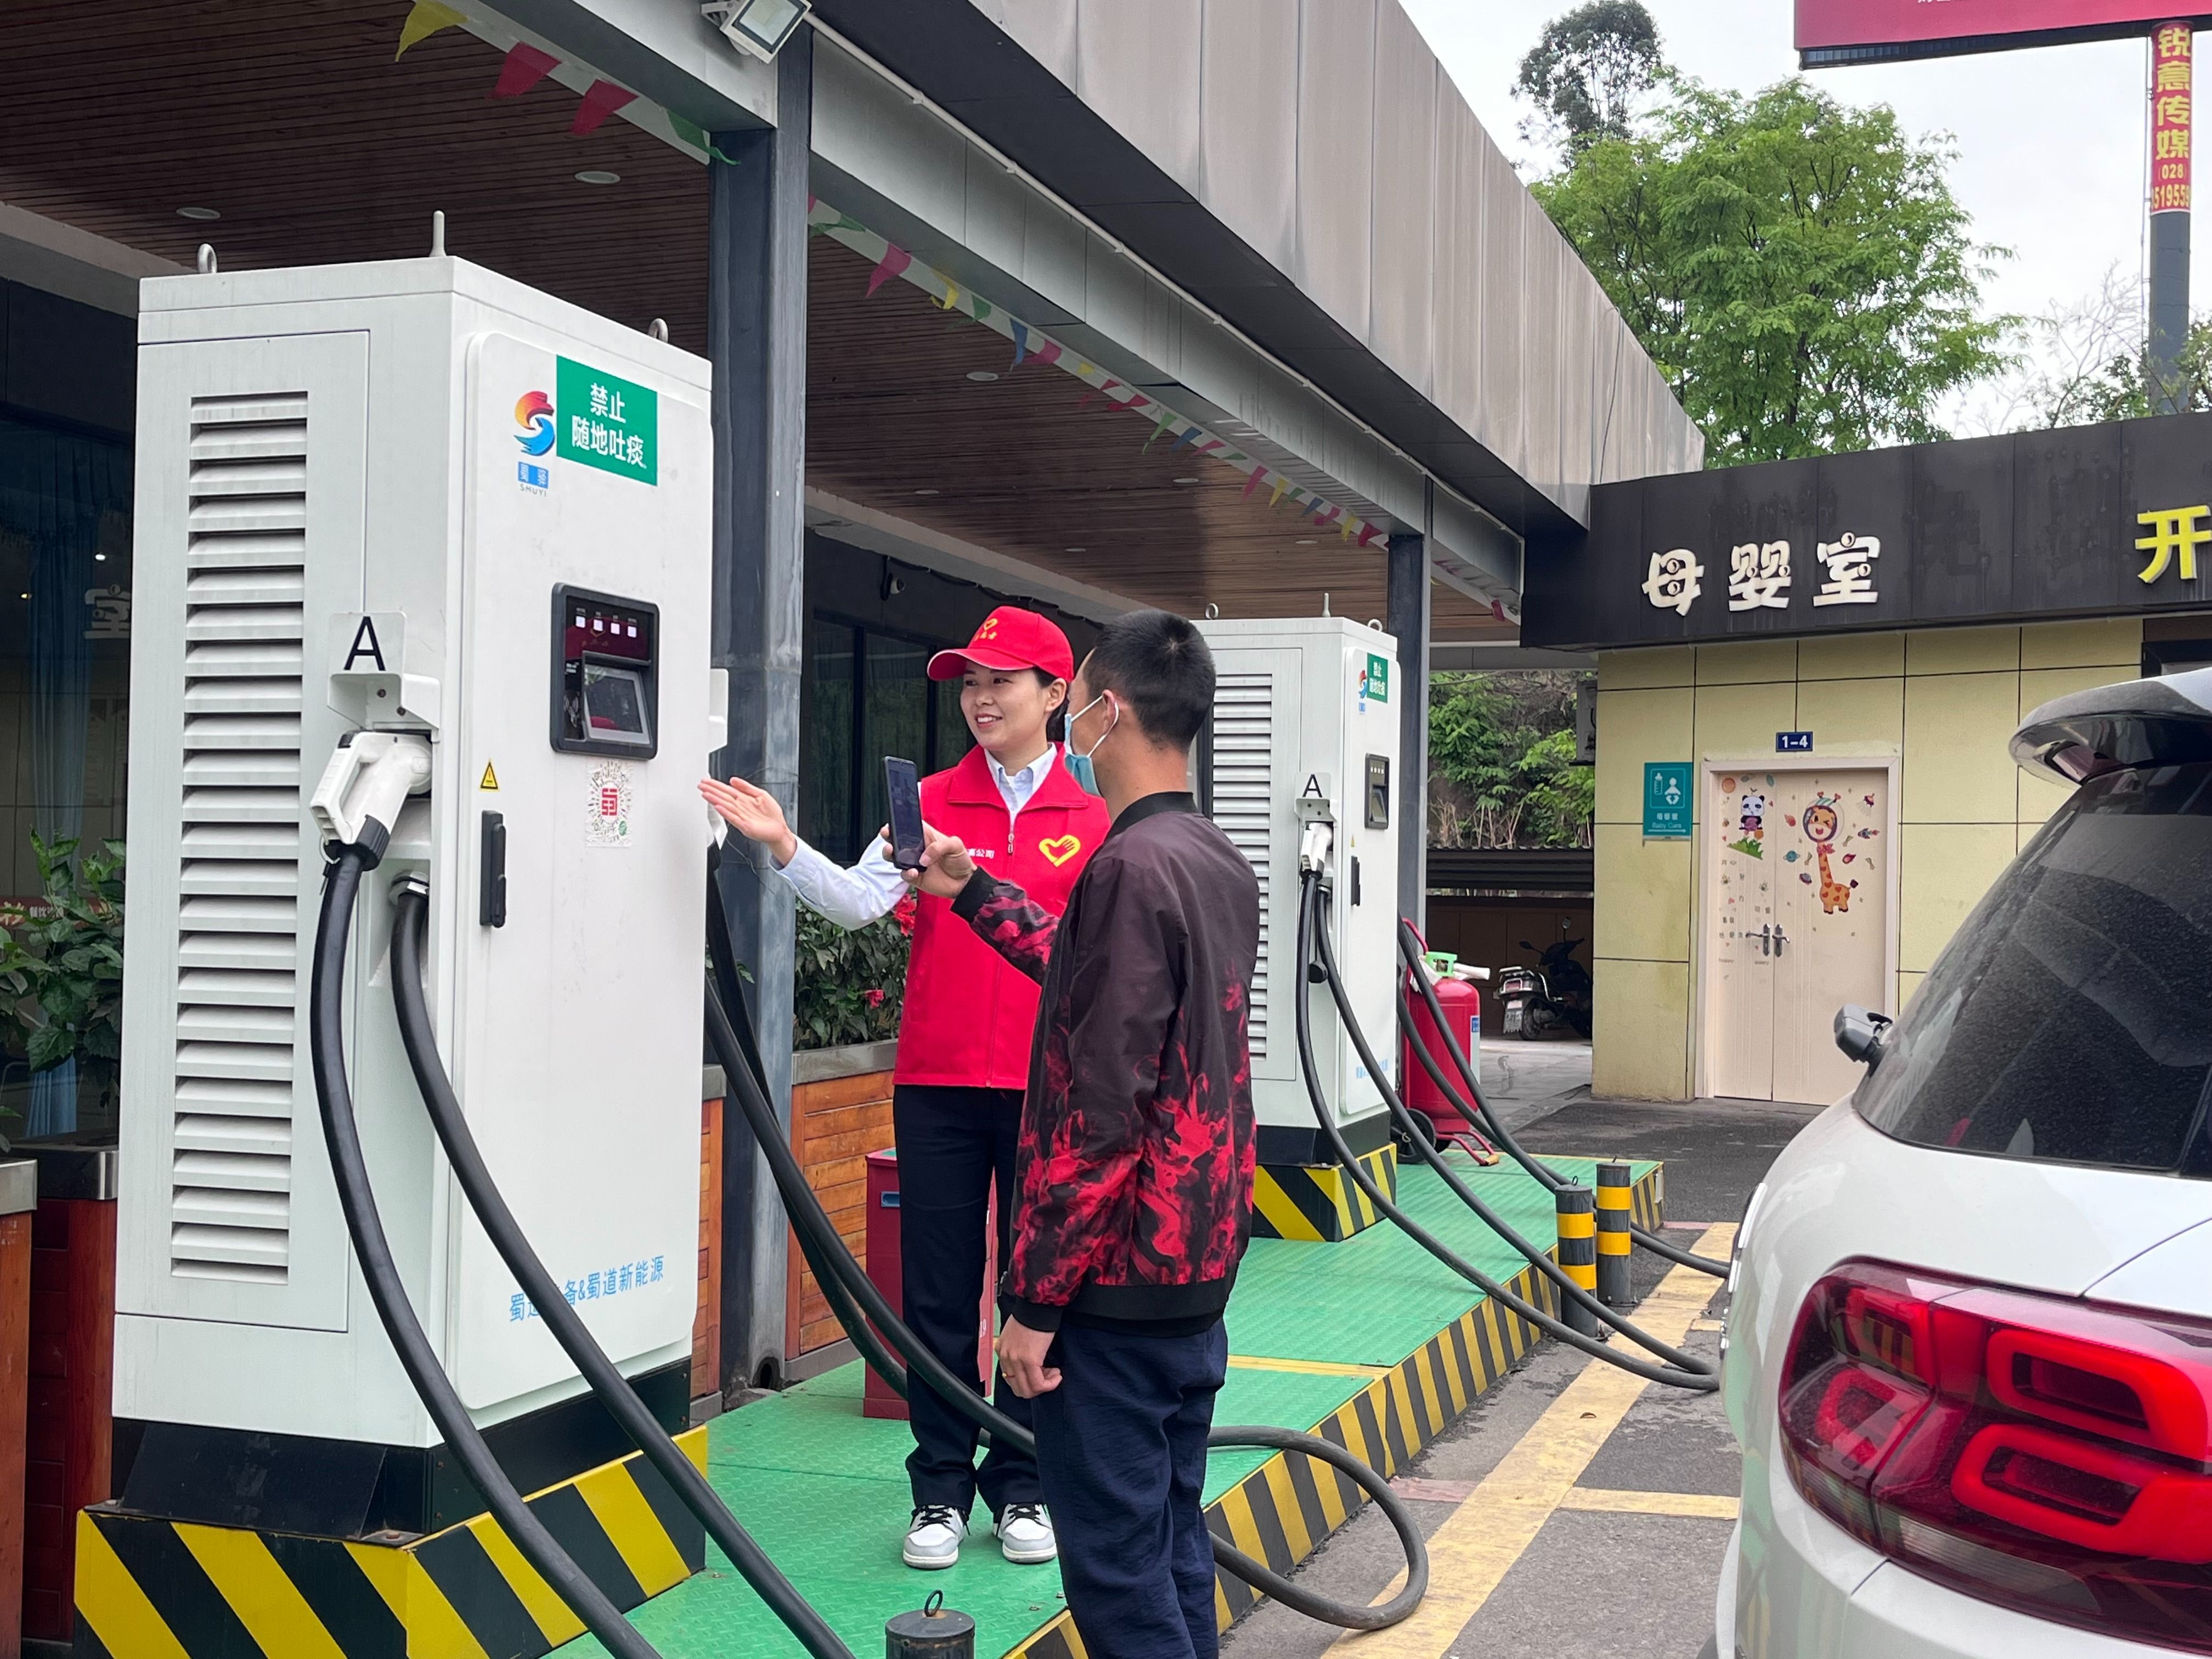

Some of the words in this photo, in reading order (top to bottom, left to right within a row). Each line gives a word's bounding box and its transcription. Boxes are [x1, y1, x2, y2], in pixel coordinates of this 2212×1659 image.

[2156, 28, 2191, 160] 锐意传媒
[590, 382, 626, 424] 禁止
[572, 415, 646, 469] 随地吐痰
[521, 483, 546, 496] SHUYI
[2135, 505, 2212, 583] 开
[1641, 532, 1880, 616] 母婴室
[344, 616, 386, 670] A
[1781, 735, 1808, 748] 1-4
[1302, 774, 1322, 798] A
